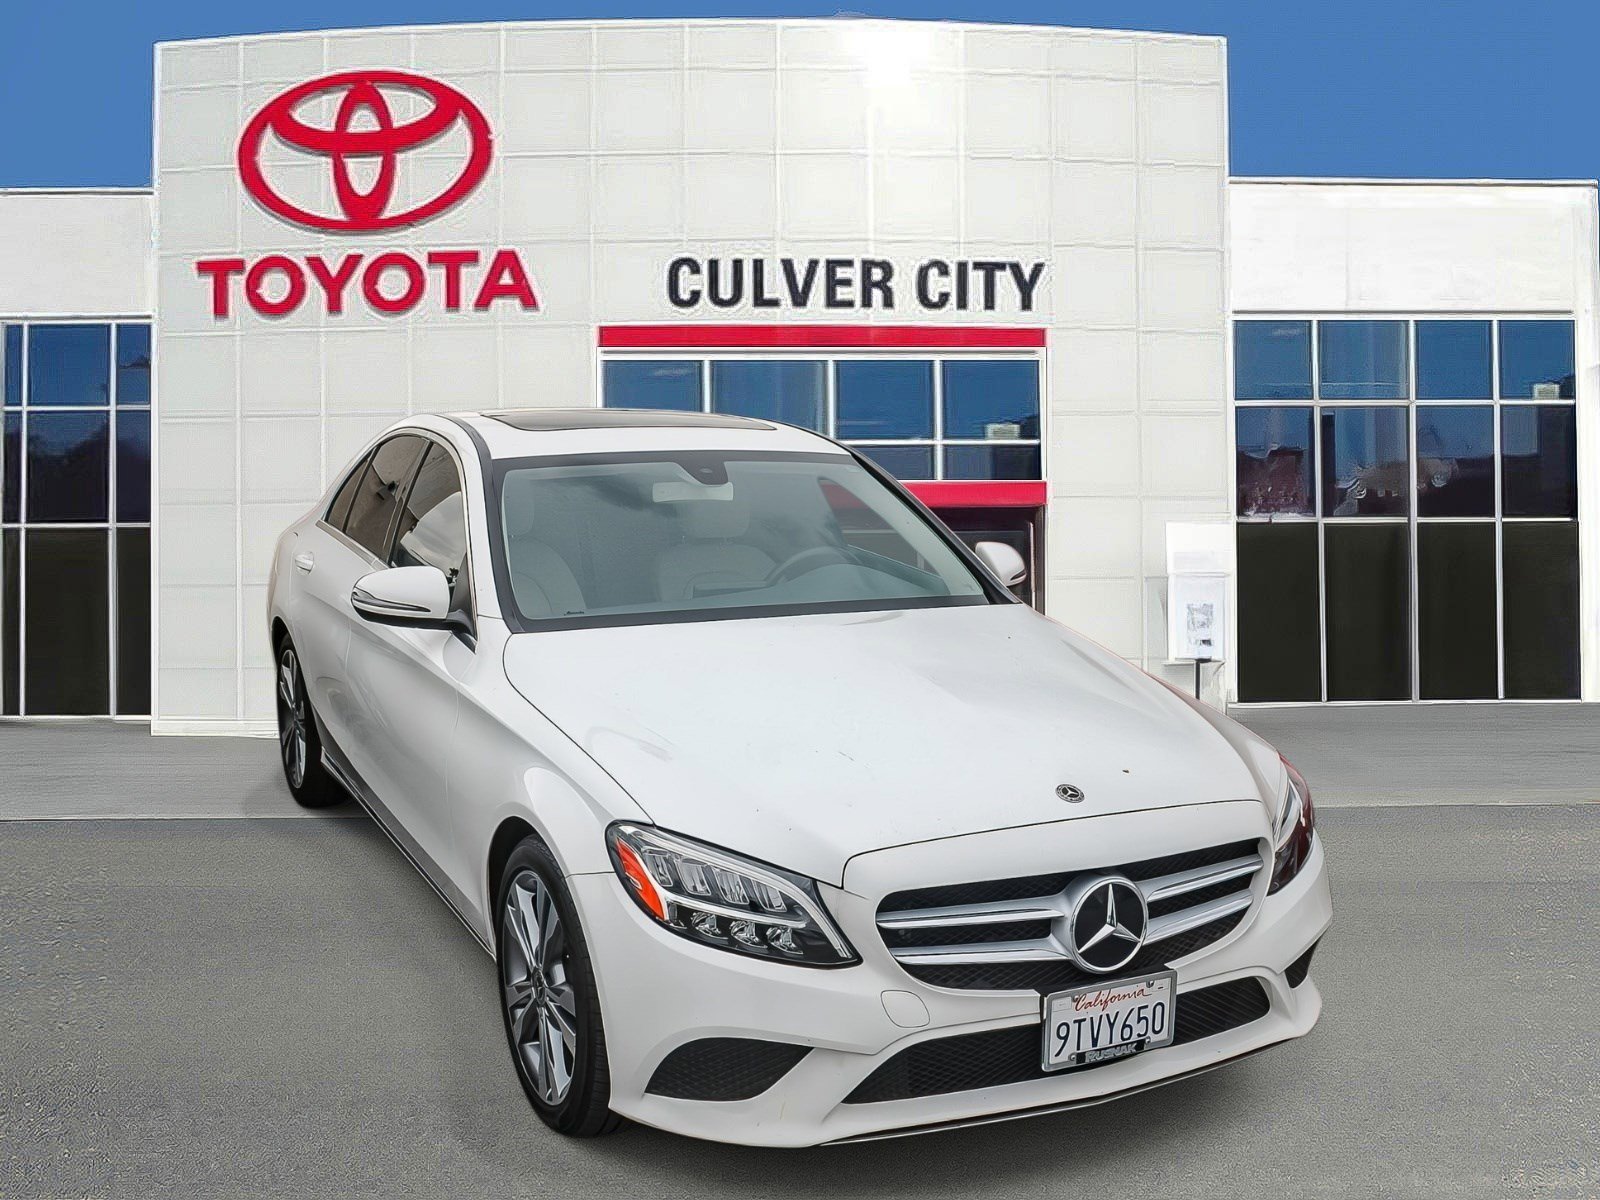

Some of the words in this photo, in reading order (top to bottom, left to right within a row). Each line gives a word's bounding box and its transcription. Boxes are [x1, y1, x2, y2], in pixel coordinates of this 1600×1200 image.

[197, 249, 539, 319] TOYOTA
[667, 257, 895, 308] CULVER
[916, 259, 1046, 311] CITY
[1075, 986, 1152, 1011] California
[1054, 1002, 1165, 1057] 9TVY650
[1085, 1043, 1137, 1062] RUSNAK
